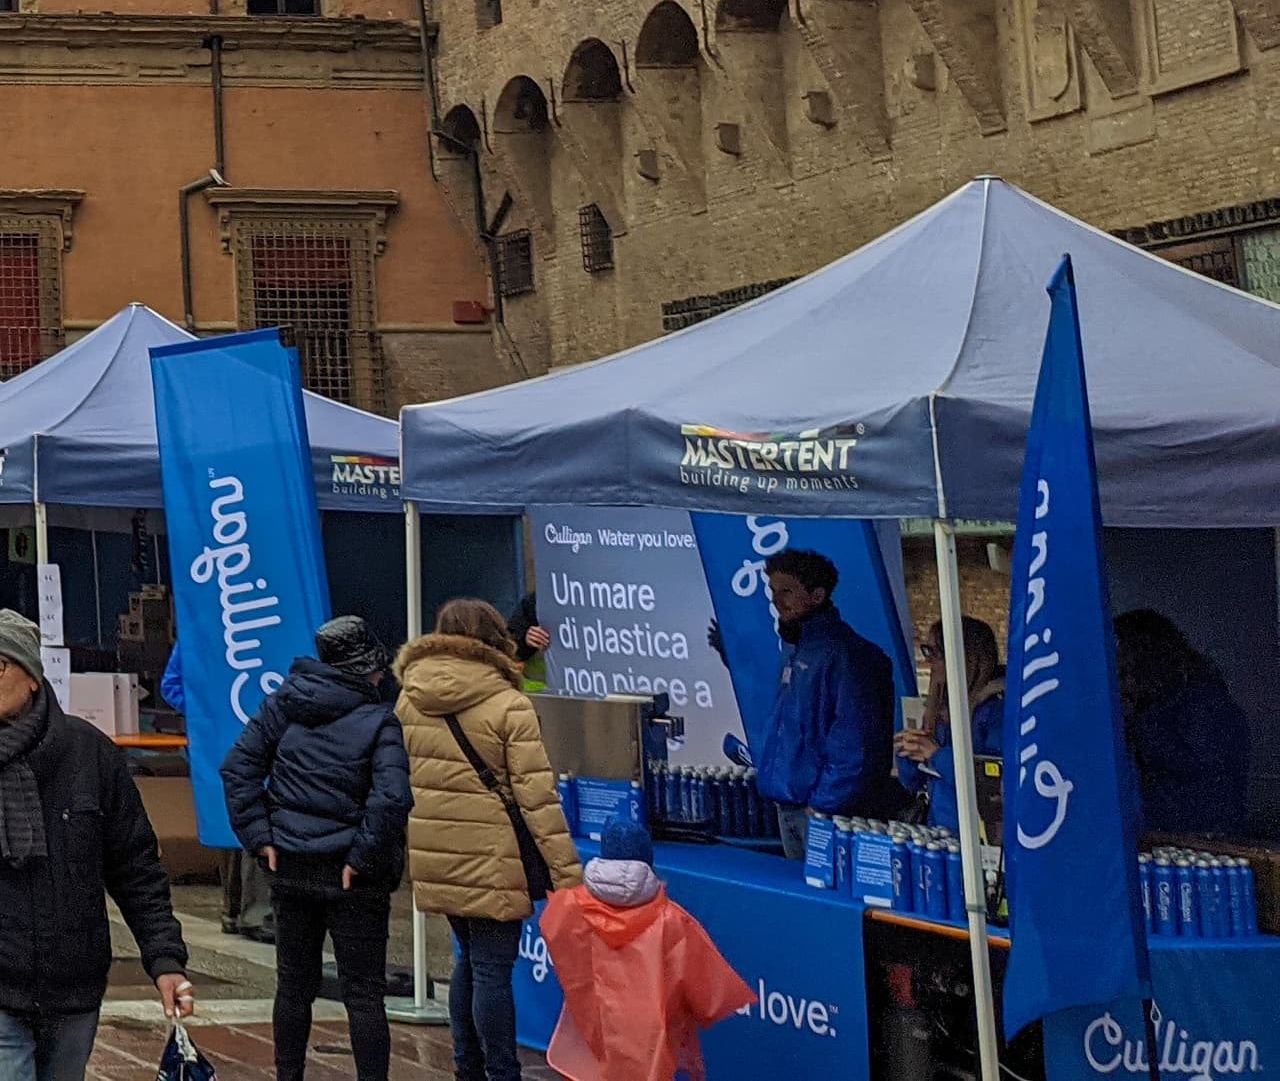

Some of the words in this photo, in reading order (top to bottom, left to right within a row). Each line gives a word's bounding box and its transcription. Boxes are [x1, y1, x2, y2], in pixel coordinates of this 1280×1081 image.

[681, 437, 857, 471] MASTERTENT
[332, 483, 388, 500] building
[392, 489, 400, 497] u
[680, 466, 751, 493] building
[757, 475, 778, 494] up
[786, 475, 858, 490] moments
[544, 523, 593, 554] Culligan
[597, 528, 636, 548] Water
[637, 532, 662, 551] you
[551, 572, 586, 607] Un
[588, 581, 656, 612] mare
[558, 617, 580, 650] di
[582, 619, 690, 661] plastica
[563, 667, 608, 696] non
[694, 679, 714, 709] a
[1084, 1011, 1263, 1081] Culigan
